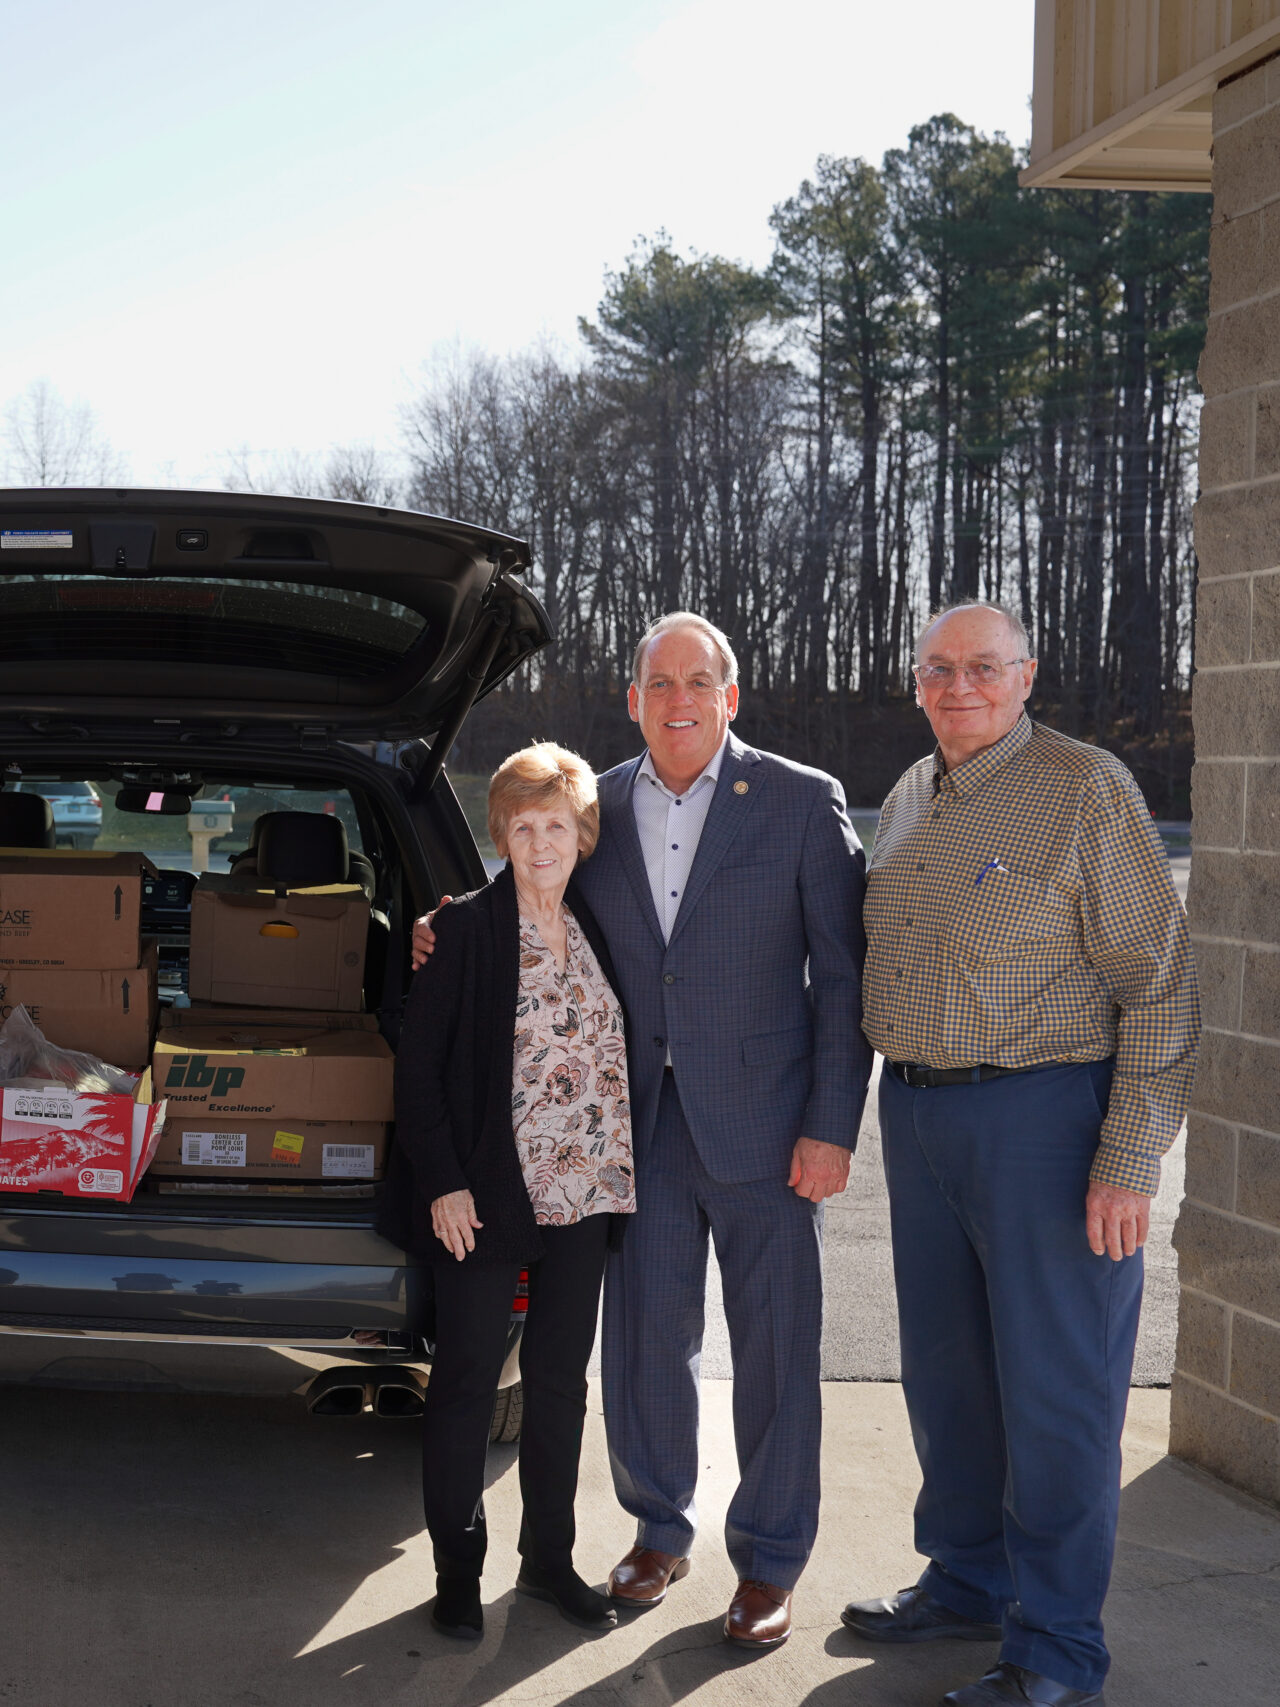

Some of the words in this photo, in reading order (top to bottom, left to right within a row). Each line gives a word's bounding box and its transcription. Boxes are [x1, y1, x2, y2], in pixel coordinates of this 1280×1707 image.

[165, 1055, 246, 1097] ibp
[164, 1093, 208, 1102] Trusted
[211, 1139, 232, 1147] CENTER
